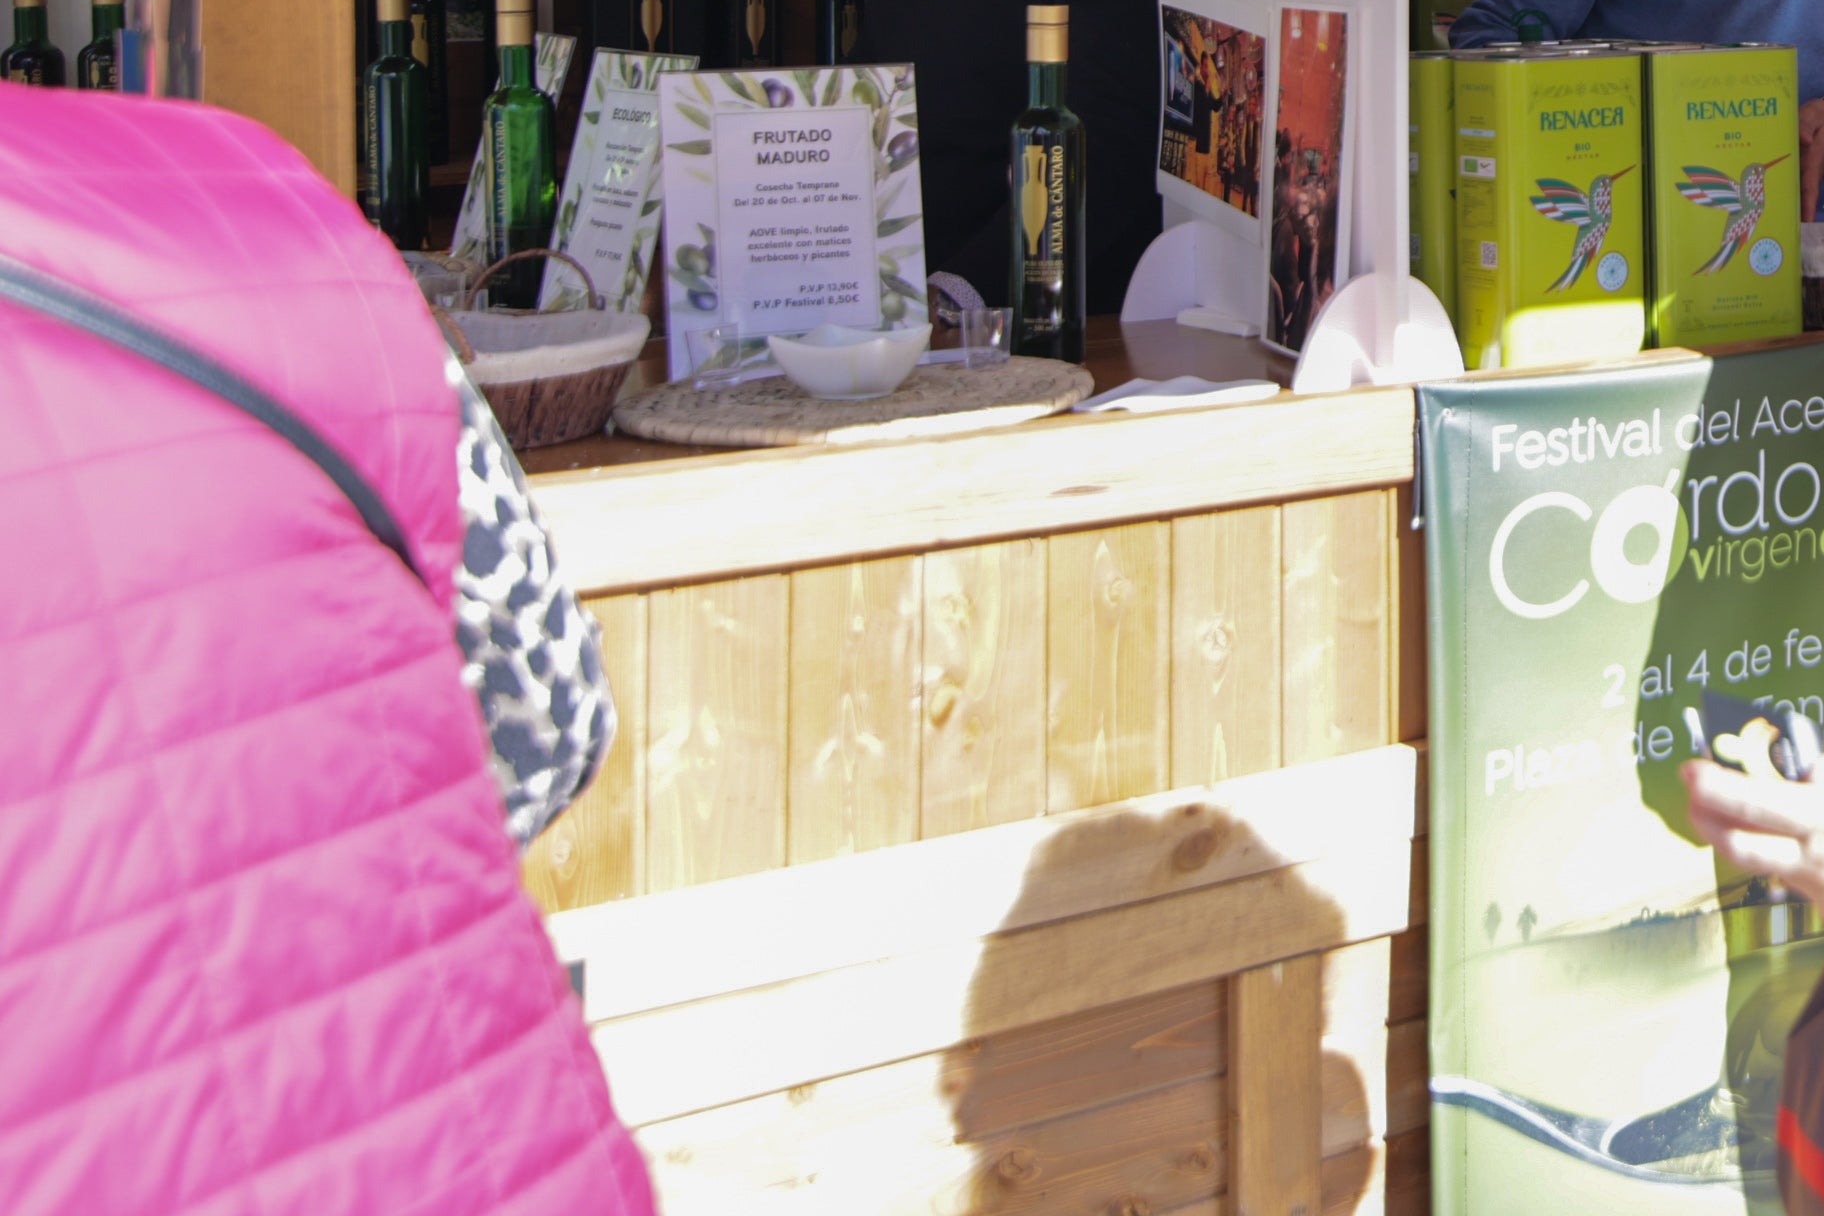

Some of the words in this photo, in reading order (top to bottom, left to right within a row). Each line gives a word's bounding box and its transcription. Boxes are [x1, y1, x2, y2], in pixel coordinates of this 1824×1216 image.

[1686, 97, 1778, 121] RENACER
[1540, 106, 1625, 132] RENACER
[753, 129, 832, 145] FRUTADO
[1724, 131, 1742, 141] BIO
[1574, 143, 1591, 152] BIO
[757, 149, 830, 165] MADURO
[1050, 145, 1064, 205] CÁNTARO
[756, 182, 794, 192] Cosecha
[797, 181, 840, 193] Temprana
[734, 198, 750, 207] Del
[767, 196, 778, 205] de
[803, 195, 811, 203] al
[828, 194, 839, 202] de
[1053, 206, 1063, 221] de
[749, 228, 777, 237] AOVE
[815, 224, 850, 234] frutado
[1051, 222, 1063, 254] ALMA
[747, 241, 793, 251] excelente
[796, 240, 812, 248] con
[815, 237, 852, 247] matices
[802, 254, 809, 262] y
[810, 250, 851, 261] picantes
[753, 298, 782, 310] P.V.P
[784, 296, 825, 307] Festival
[1491, 407, 1662, 473] Festival
[1674, 398, 1741, 452] del
[1599, 662, 1627, 709] 2
[1640, 654, 1673, 699] al
[1685, 649, 1711, 688] 4
[1723, 639, 1772, 681] de
